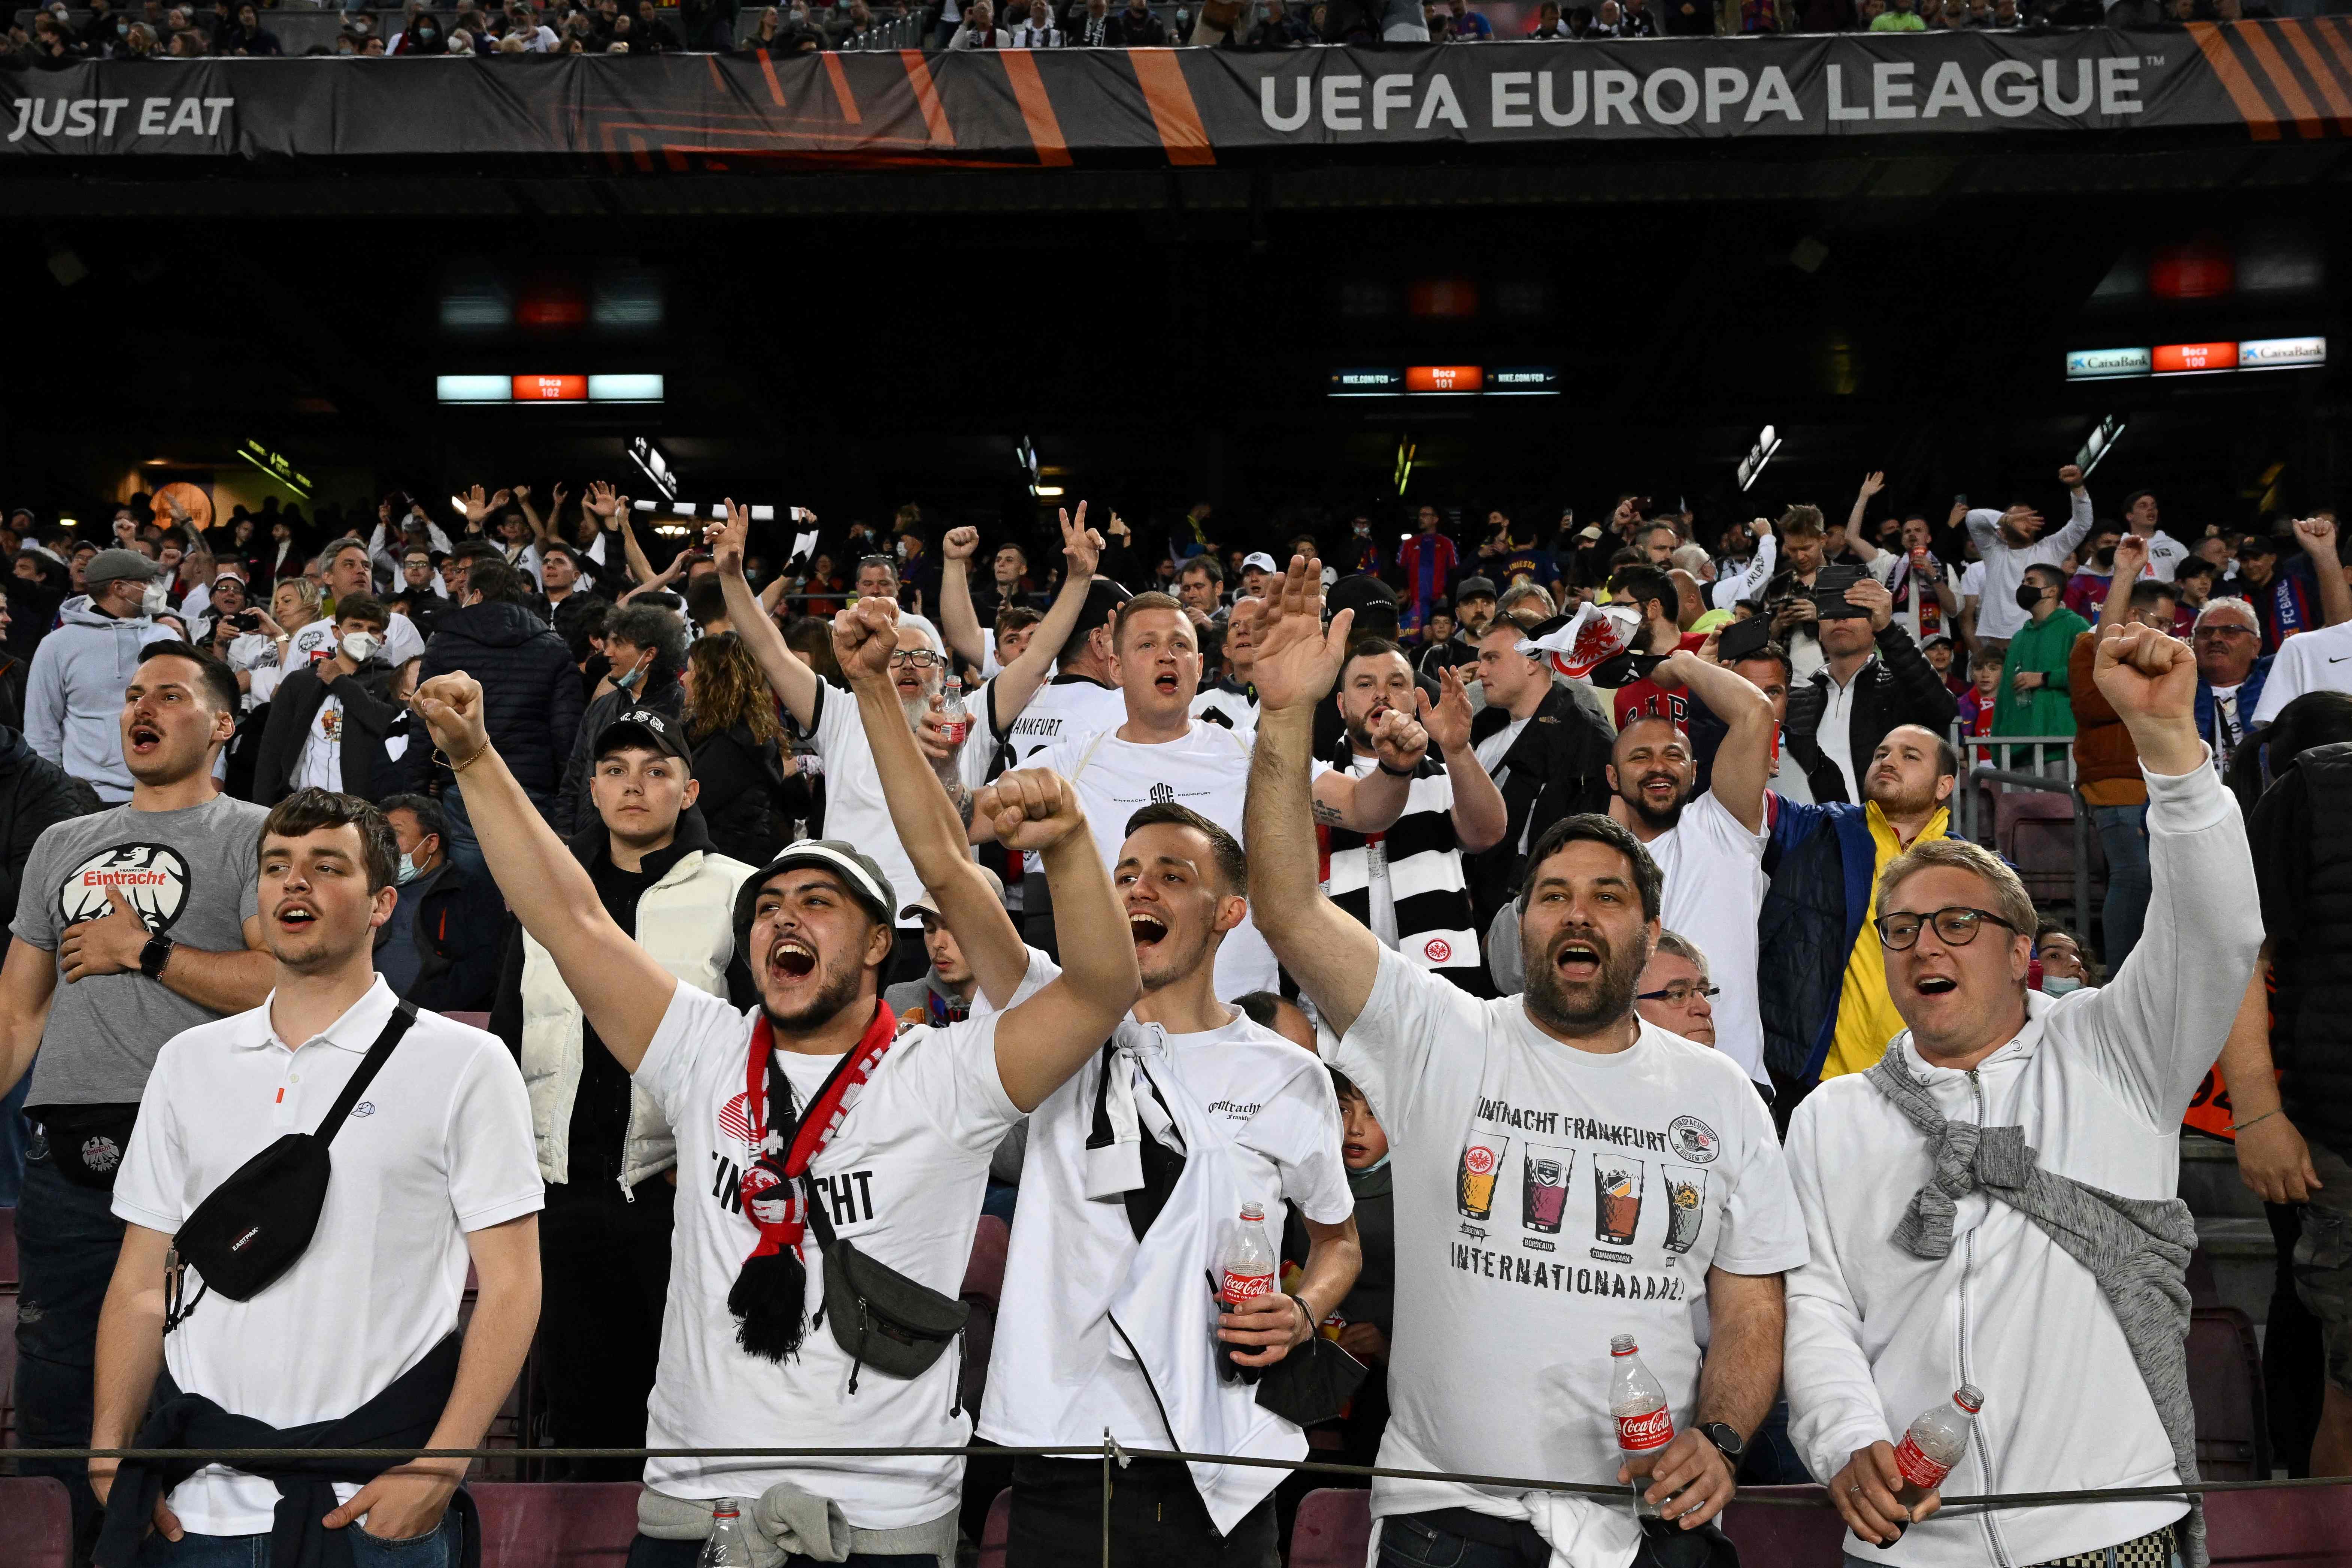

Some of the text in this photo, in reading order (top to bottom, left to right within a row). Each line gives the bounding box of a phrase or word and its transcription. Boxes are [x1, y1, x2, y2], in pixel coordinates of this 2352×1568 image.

[1260, 73, 1469, 131] UEFA
[1491, 64, 1803, 128] EUROPA
[1826, 56, 2143, 121] LEAGUE
[7, 97, 234, 142] JUST EAT
[2182, 347, 2208, 356] Boca
[2261, 345, 2323, 360] CaixaBank
[2087, 355, 2148, 369] CaixaBank
[2185, 357, 2206, 367] 100
[1433, 368, 1456, 378] Boca
[539, 378, 561, 387] Boca
[1436, 379, 1453, 389] 101
[542, 388, 560, 397] 102
[84, 870, 167, 886] Eintracht
[1564, 1116, 1666, 1152] FRANKFURT
[86, 1144, 111, 1156] Eintracht
[1679, 1149, 1700, 1162] DIESEM
[232, 1227, 258, 1251] EASTPAK
[1525, 1239, 1554, 1250] BORDEAUX
[1592, 1250, 1630, 1262] COMMANDARIA
[1224, 1274, 1270, 1295] Coca-Cola
[1622, 1407, 1669, 1437] Coca-Cola
[1649, 1430, 1668, 1440] ORIGINAL
